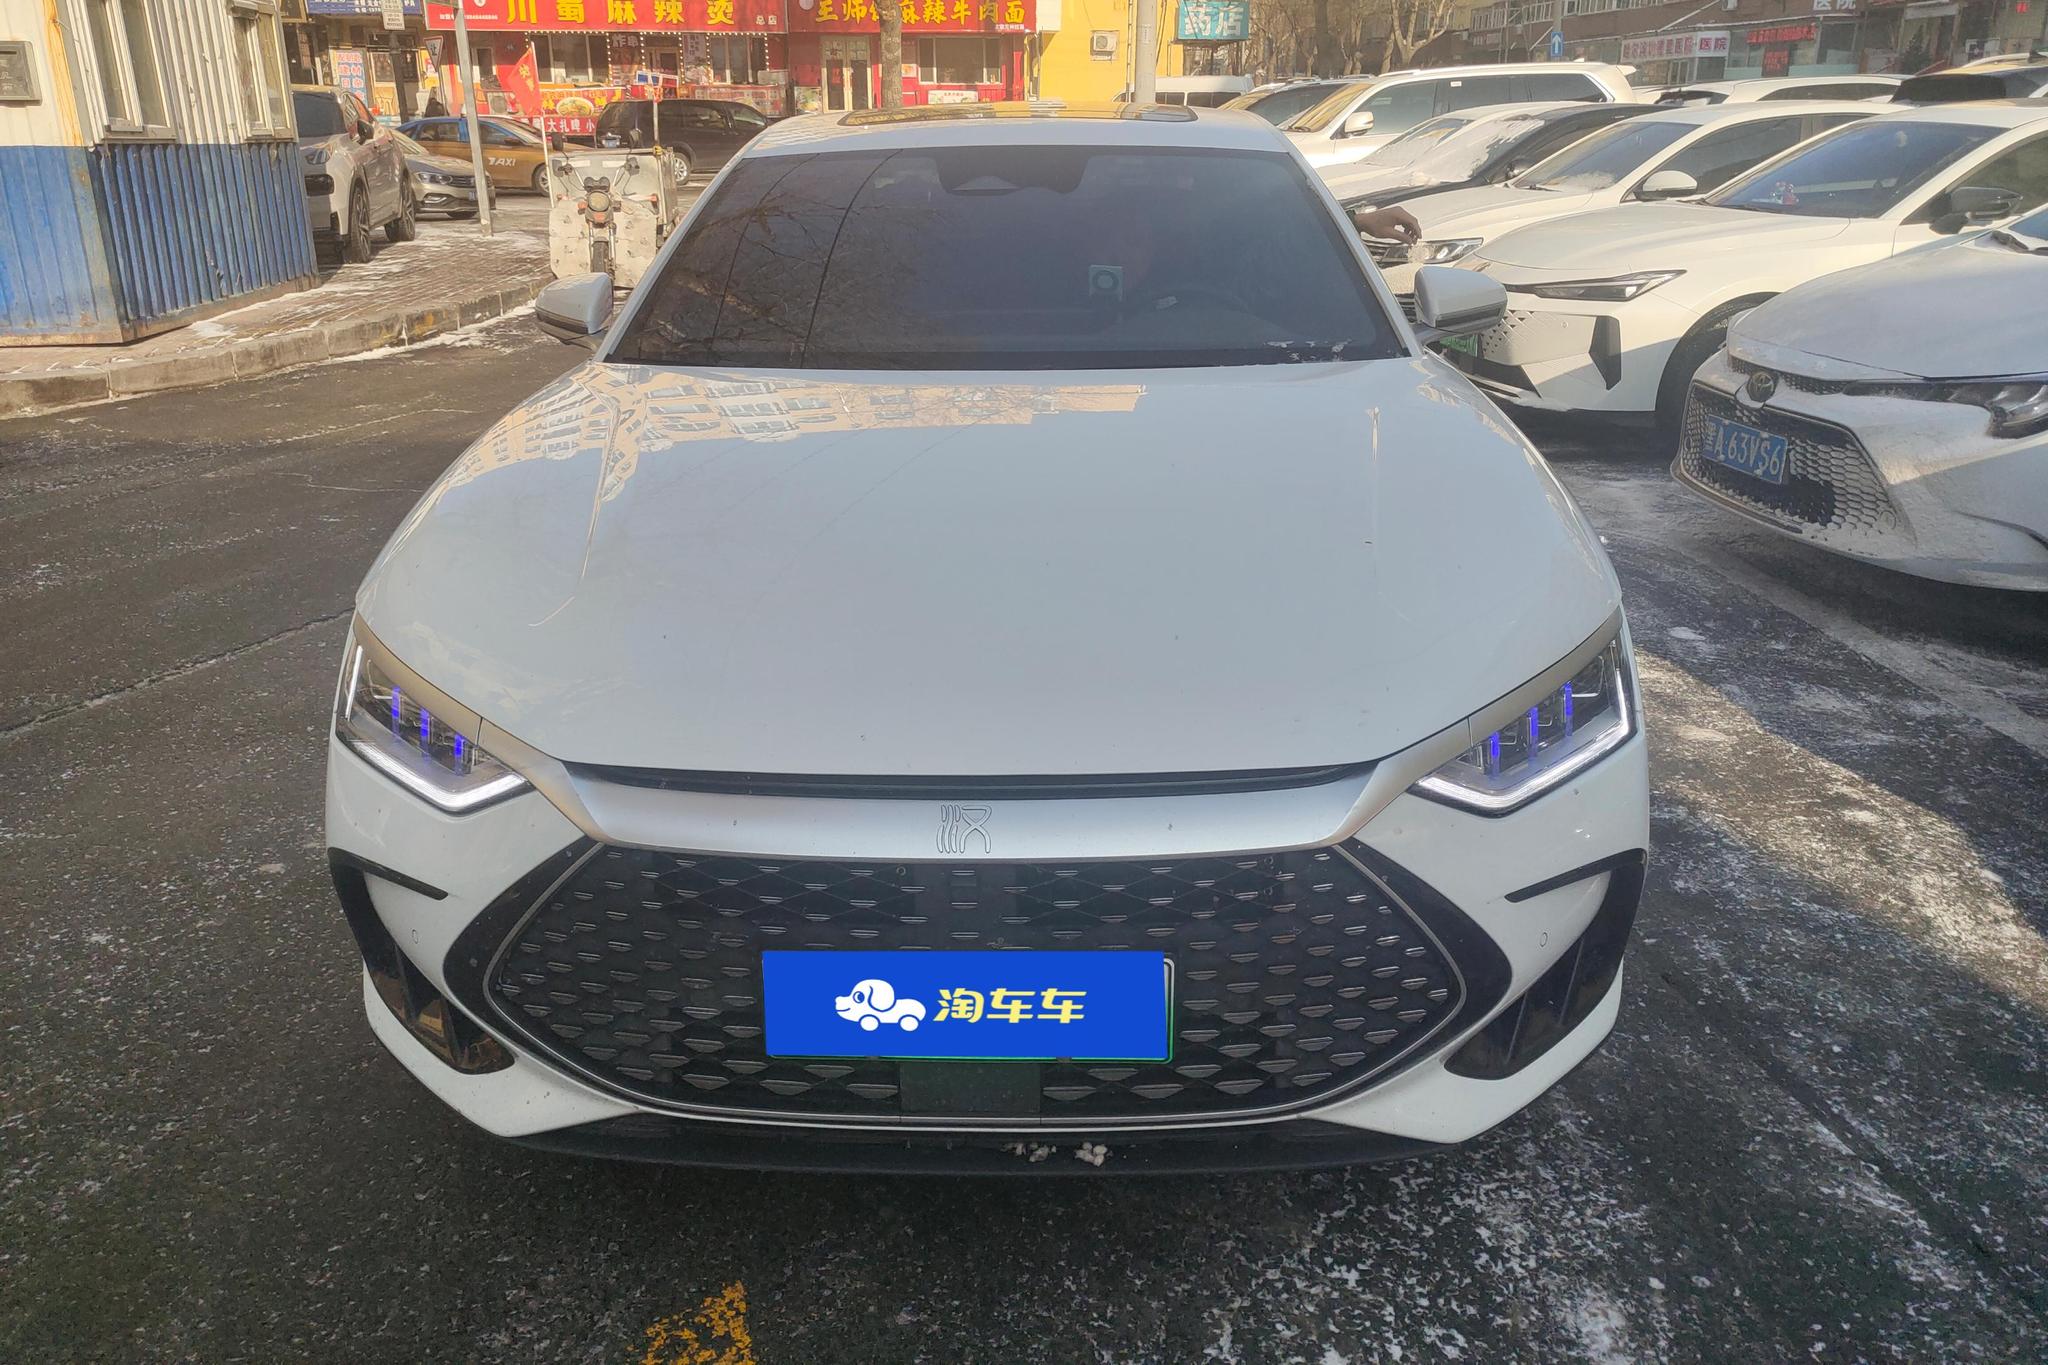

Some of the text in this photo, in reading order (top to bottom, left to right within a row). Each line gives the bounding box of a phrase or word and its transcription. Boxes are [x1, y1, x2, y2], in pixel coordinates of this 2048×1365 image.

[507, 0, 735, 25] 川蜀麻辣烫
[755, 15, 778, 25] 总店
[1184, 4, 1244, 36] 药店
[1700, 37, 1728, 51] 医院
[487, 157, 516, 166] TAXI
